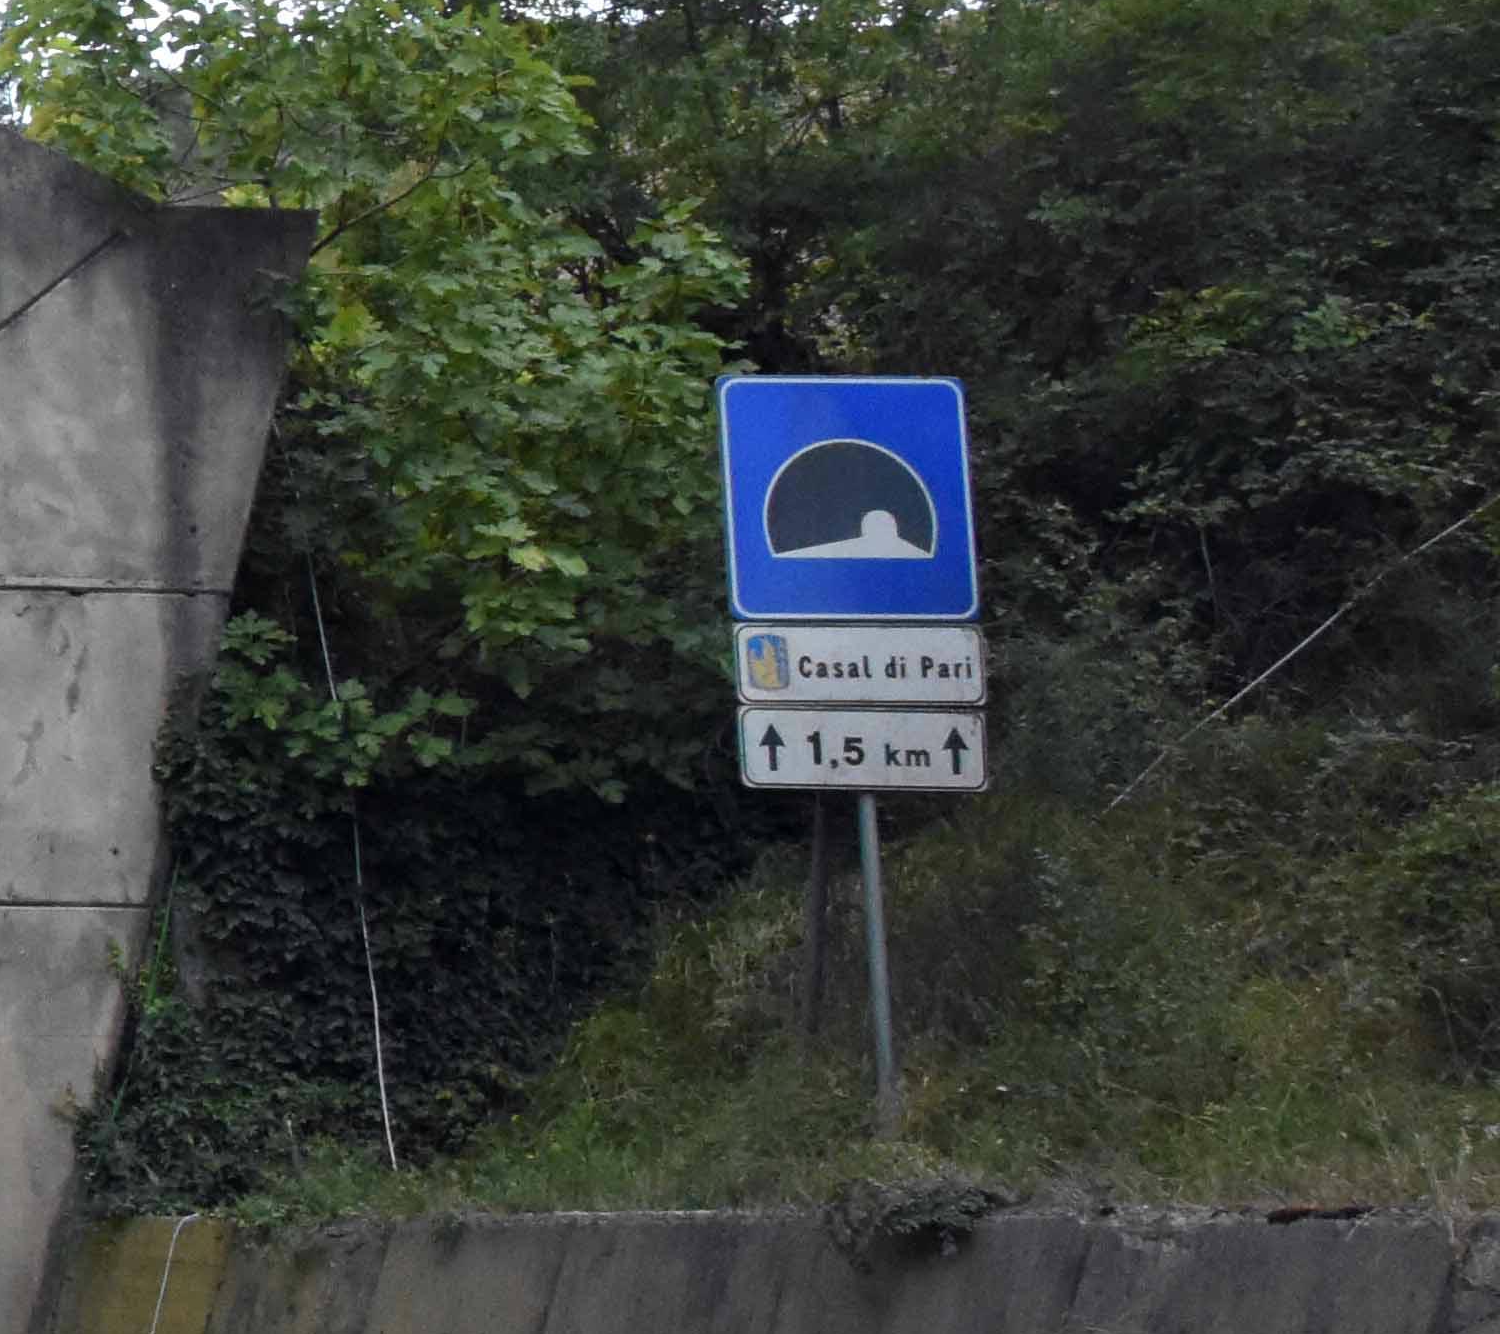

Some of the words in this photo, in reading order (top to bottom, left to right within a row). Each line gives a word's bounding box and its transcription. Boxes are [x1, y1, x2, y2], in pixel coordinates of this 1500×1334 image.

[799, 655, 872, 679] Casal
[884, 655, 907, 679] di
[920, 655, 973, 679] Pari
[806, 730, 866, 769] 1,5
[884, 743, 931, 768] km
